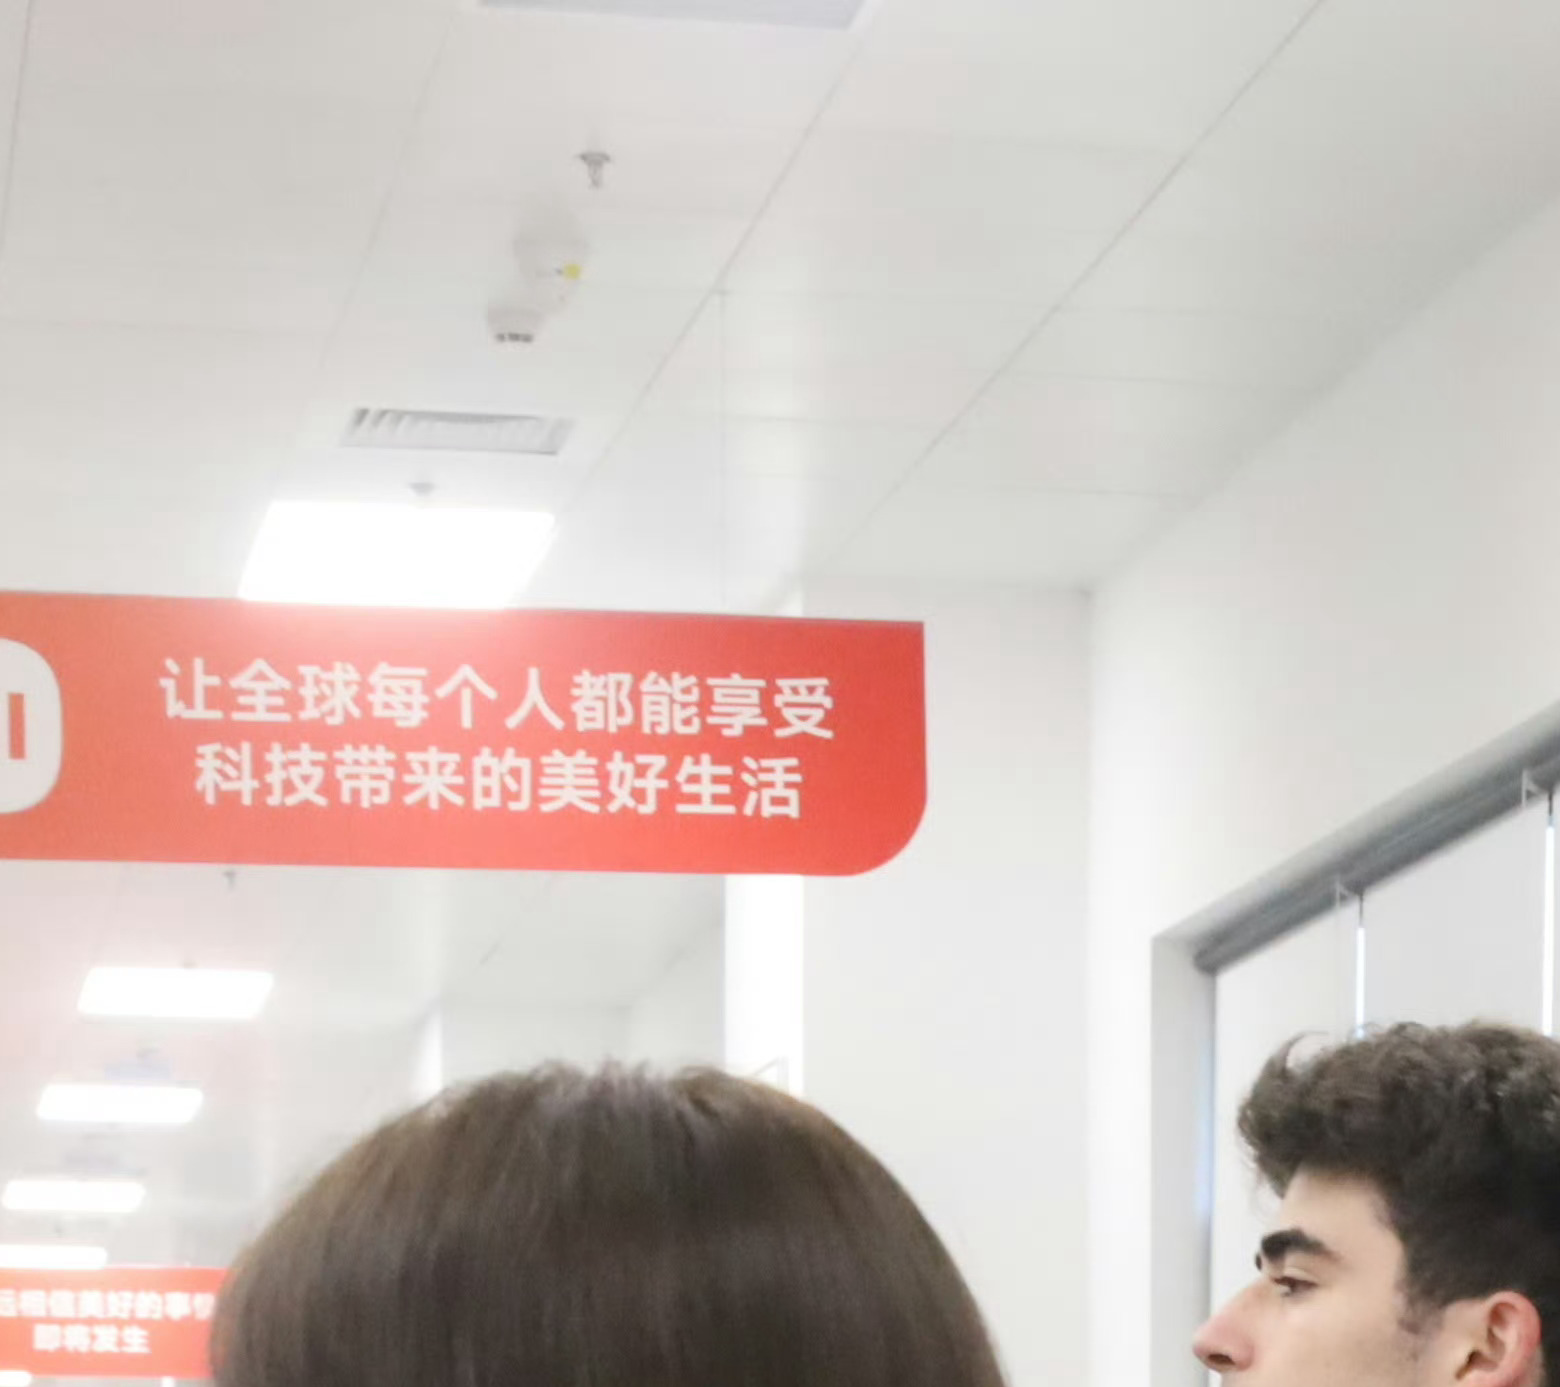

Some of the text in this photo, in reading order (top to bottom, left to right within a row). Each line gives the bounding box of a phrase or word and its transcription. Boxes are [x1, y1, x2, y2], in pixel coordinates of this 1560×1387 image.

[158, 656, 837, 743] 让全球每个人都能享受
[193, 743, 805, 819] 科技带来的美好生活
